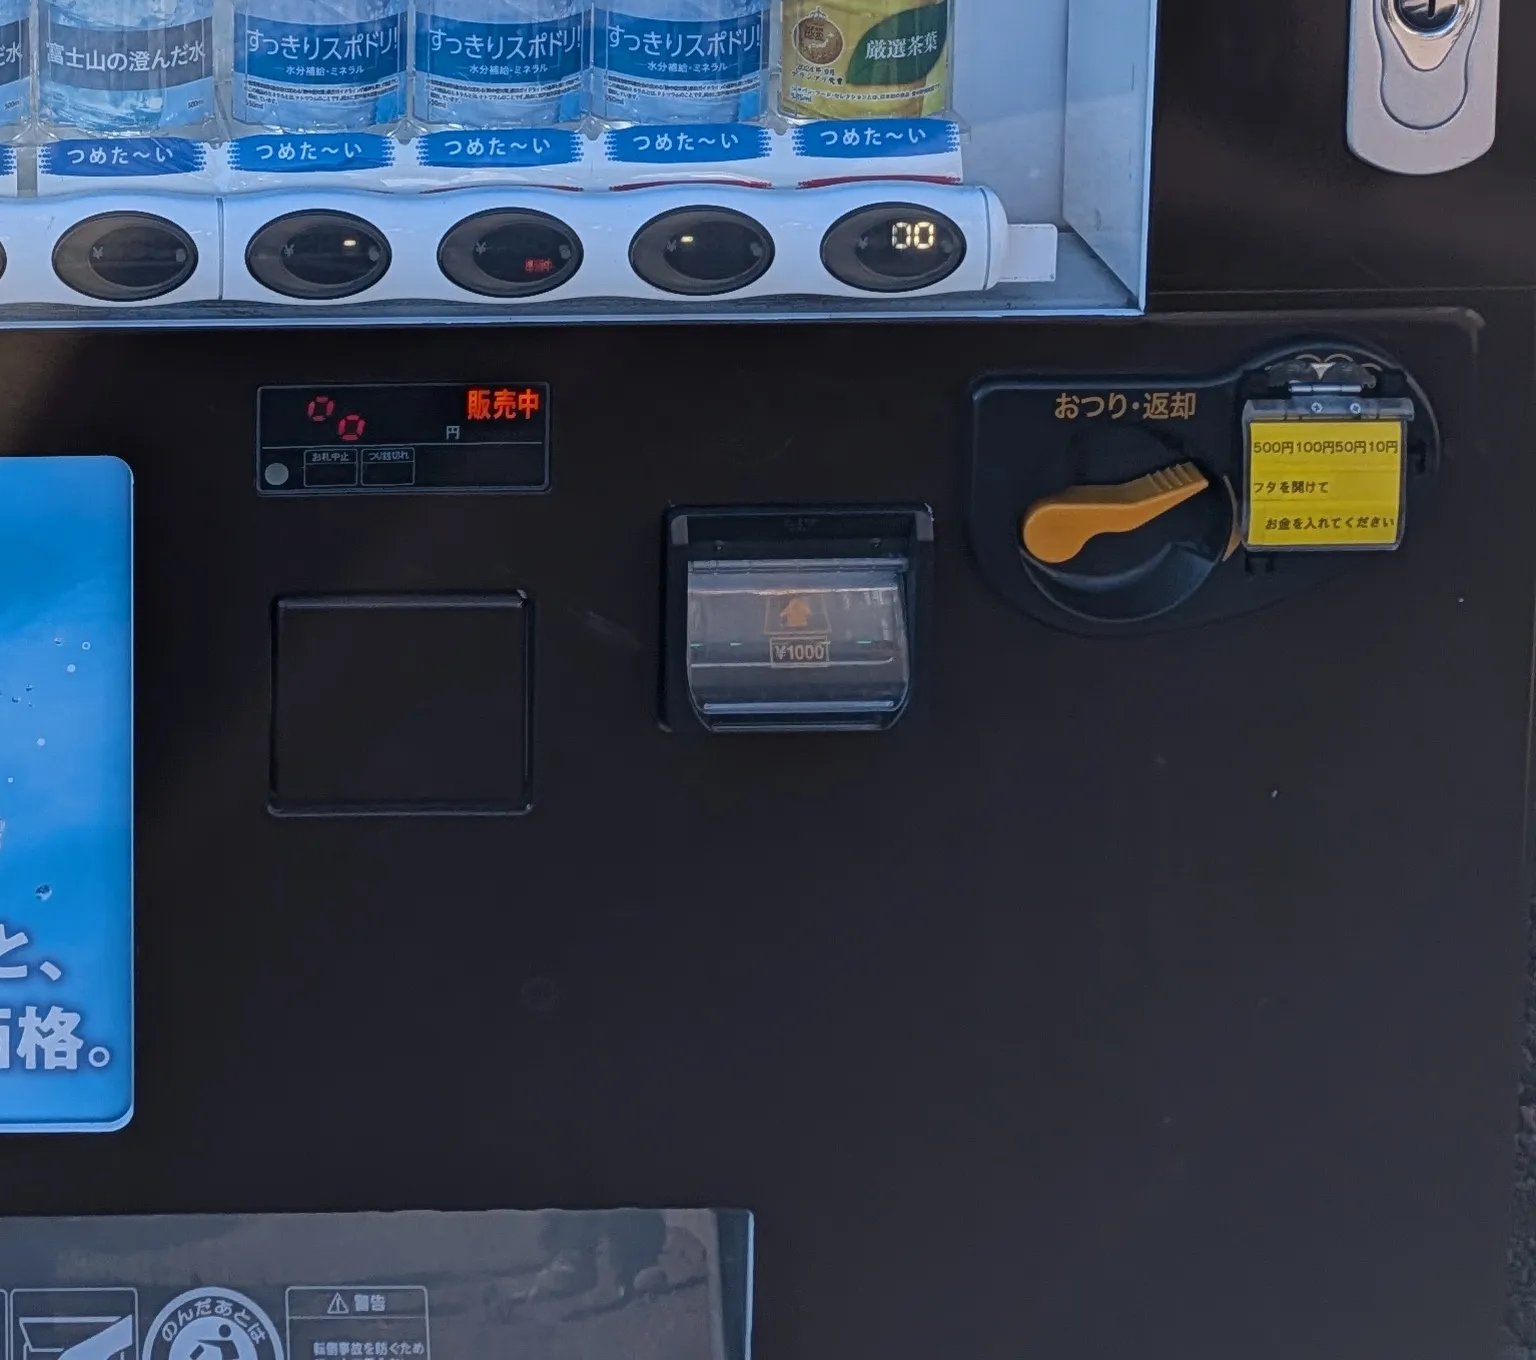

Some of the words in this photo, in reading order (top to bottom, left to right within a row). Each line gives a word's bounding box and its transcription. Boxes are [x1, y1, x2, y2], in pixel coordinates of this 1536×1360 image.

[467, 389, 540, 419] 販売中
[1055, 393, 1196, 419] おつり・返却
[446, 425, 460, 440] 円
[1254, 480, 1329, 494] フタを開けて
[1266, 516, 1396, 530] お金を入れてください
